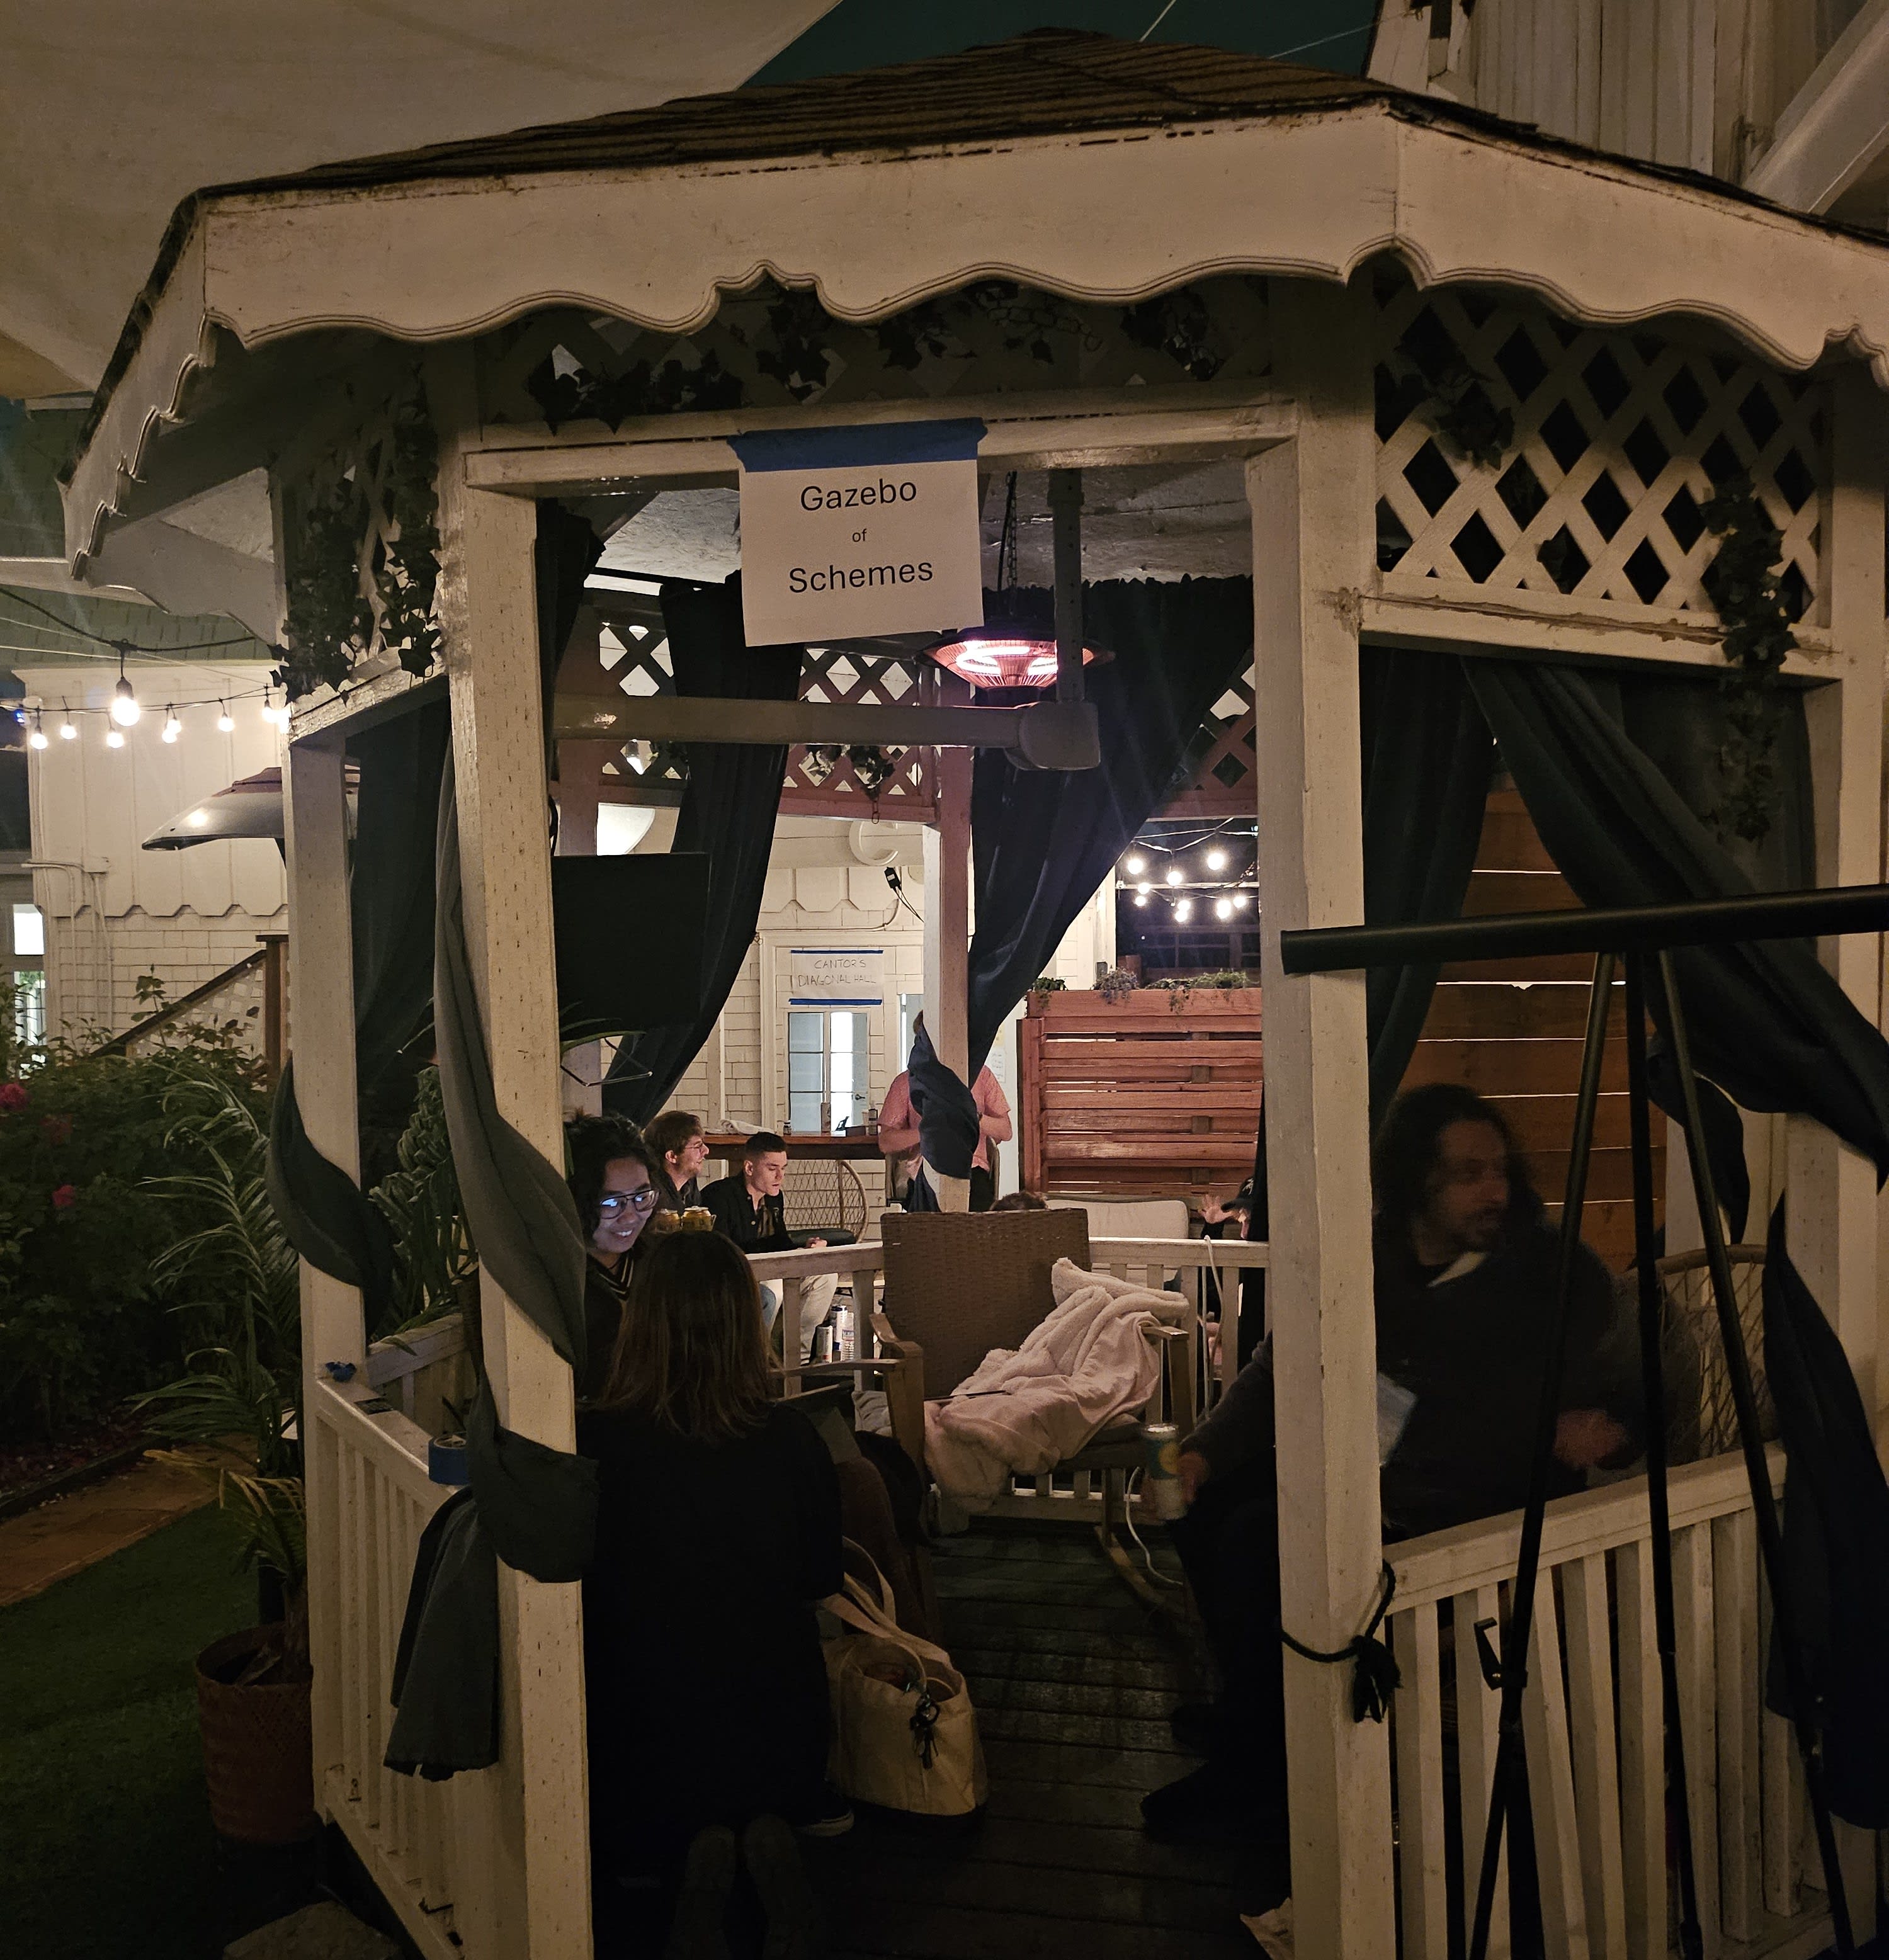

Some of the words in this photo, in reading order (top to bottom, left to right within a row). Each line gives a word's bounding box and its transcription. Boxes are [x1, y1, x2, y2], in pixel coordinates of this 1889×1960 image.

[800, 478, 917, 511] Gazebo
[851, 528, 868, 543] of
[788, 562, 934, 594] Schemes
[814, 958, 866, 968] CANTOR'S
[798, 974, 851, 987] DIAGONAL
